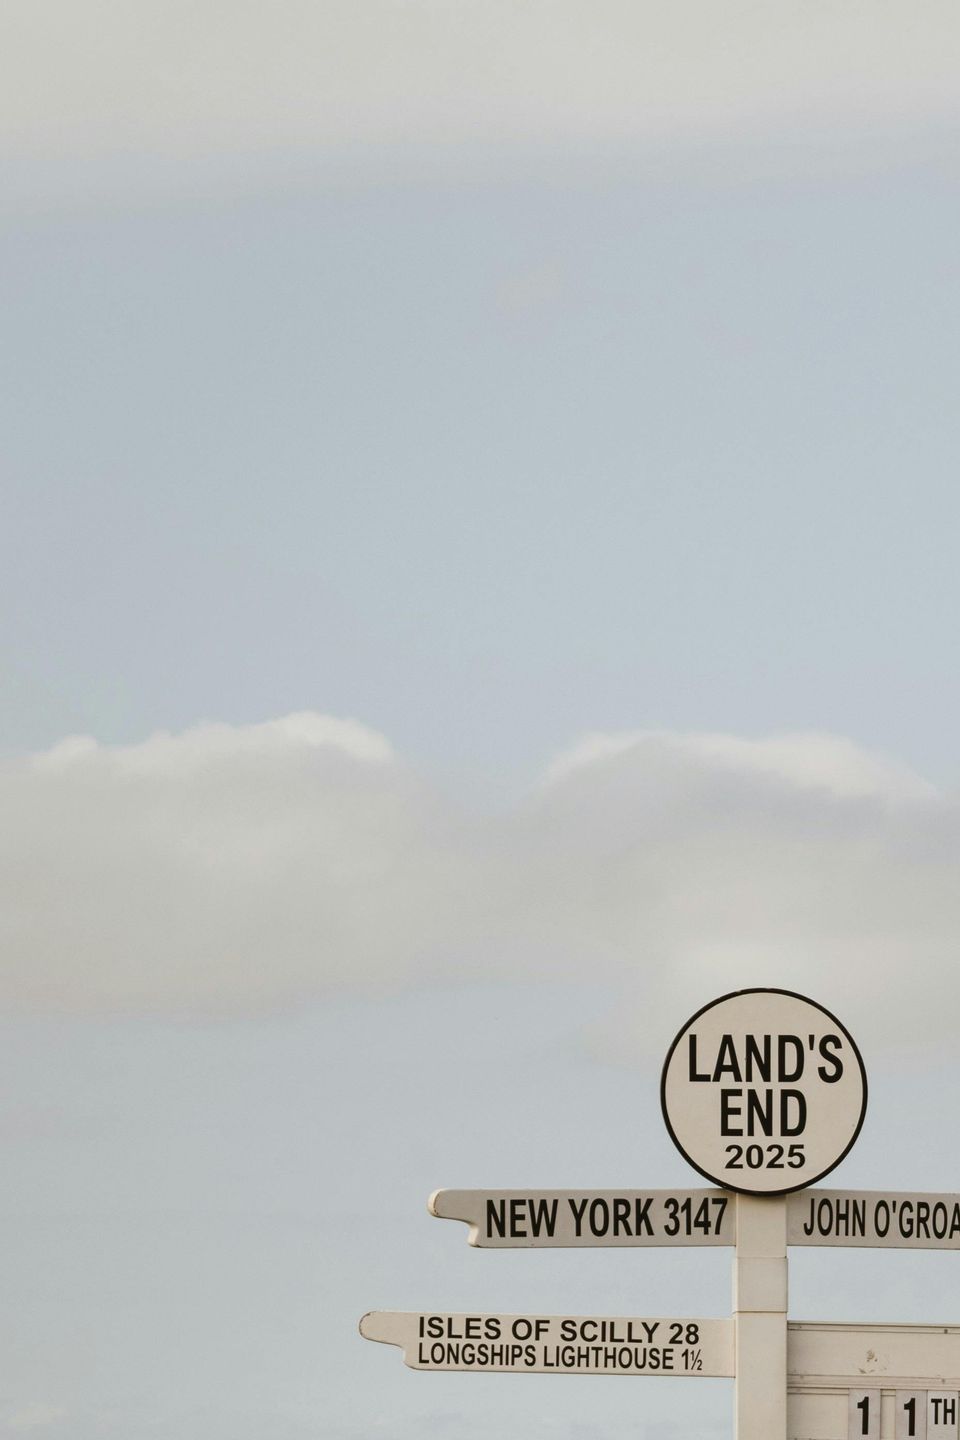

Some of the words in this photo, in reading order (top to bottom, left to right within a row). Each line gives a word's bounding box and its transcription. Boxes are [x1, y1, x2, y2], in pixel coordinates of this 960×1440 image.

[688, 1033, 844, 1084] LAND'S
[720, 1088, 807, 1137] END
[724, 1144, 806, 1169] 2025
[486, 1198, 559, 1238] NEW
[567, 1198, 655, 1237] YORK
[663, 1197, 729, 1237] 3147
[803, 1198, 866, 1237] JOHN
[419, 1316, 501, 1339] ISLES
[511, 1318, 551, 1341] OF
[560, 1320, 660, 1344] SCILLY
[669, 1323, 700, 1345] 28
[418, 1342, 537, 1367] LONGSHIPS
[543, 1346, 674, 1370] LIGHTHOUSE
